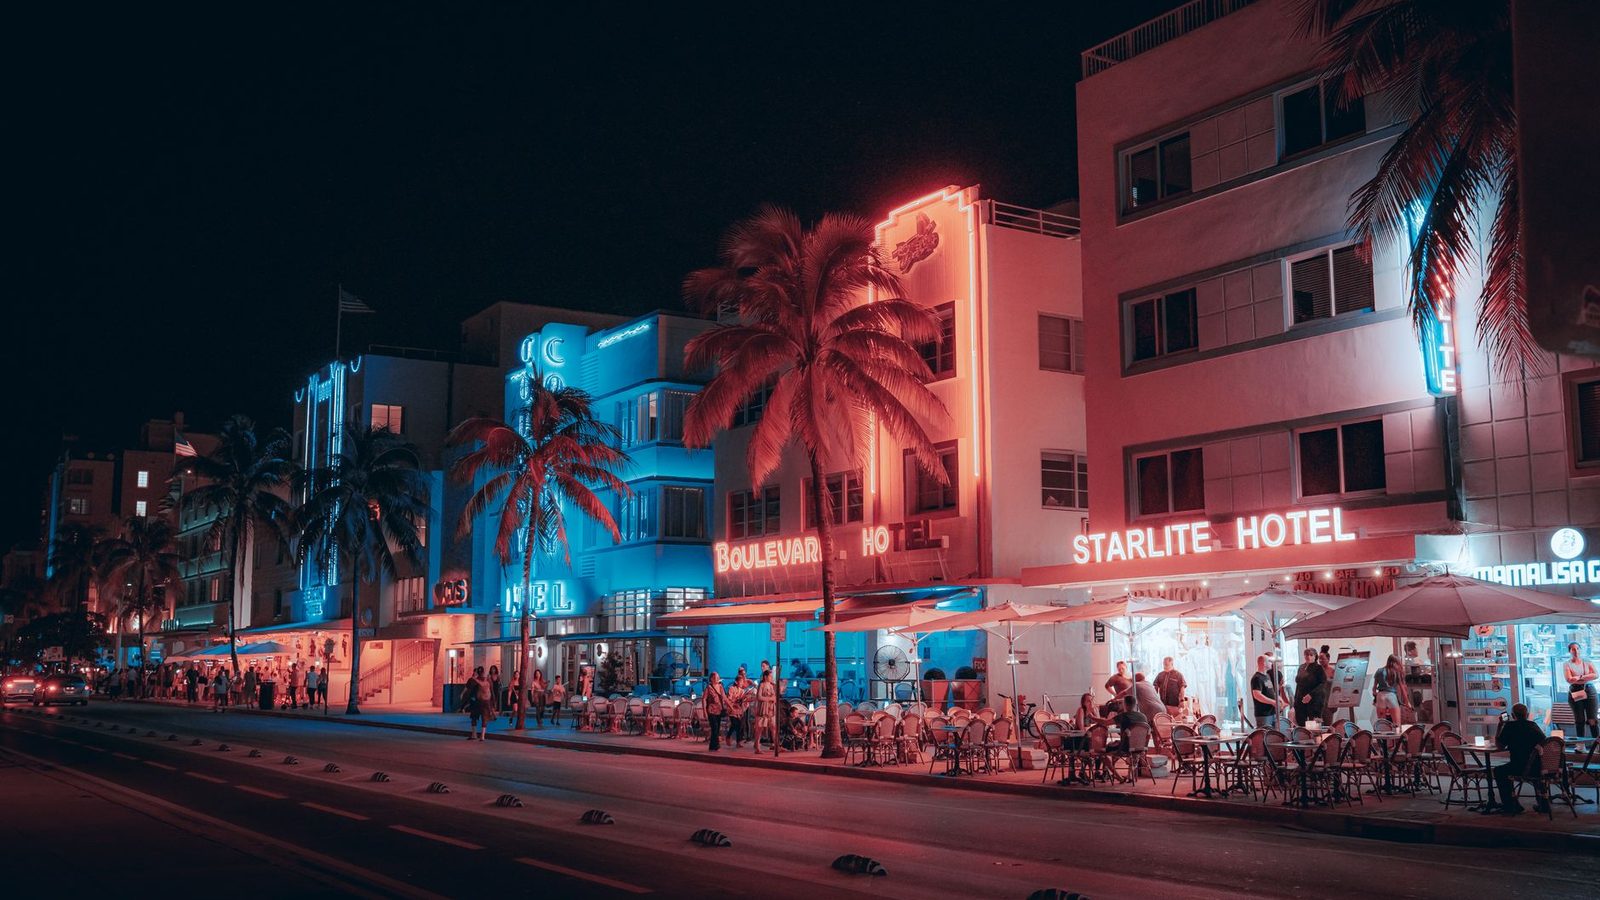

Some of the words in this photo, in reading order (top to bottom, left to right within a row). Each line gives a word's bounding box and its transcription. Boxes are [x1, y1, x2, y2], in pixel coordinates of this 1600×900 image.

[715, 535, 822, 573] BOULEVAR
[862, 518, 943, 556] HOTEL
[1073, 521, 1211, 564] STARLITE
[1236, 506, 1356, 550] HOTEL
[1473, 561, 1585, 586] MAMALISA
